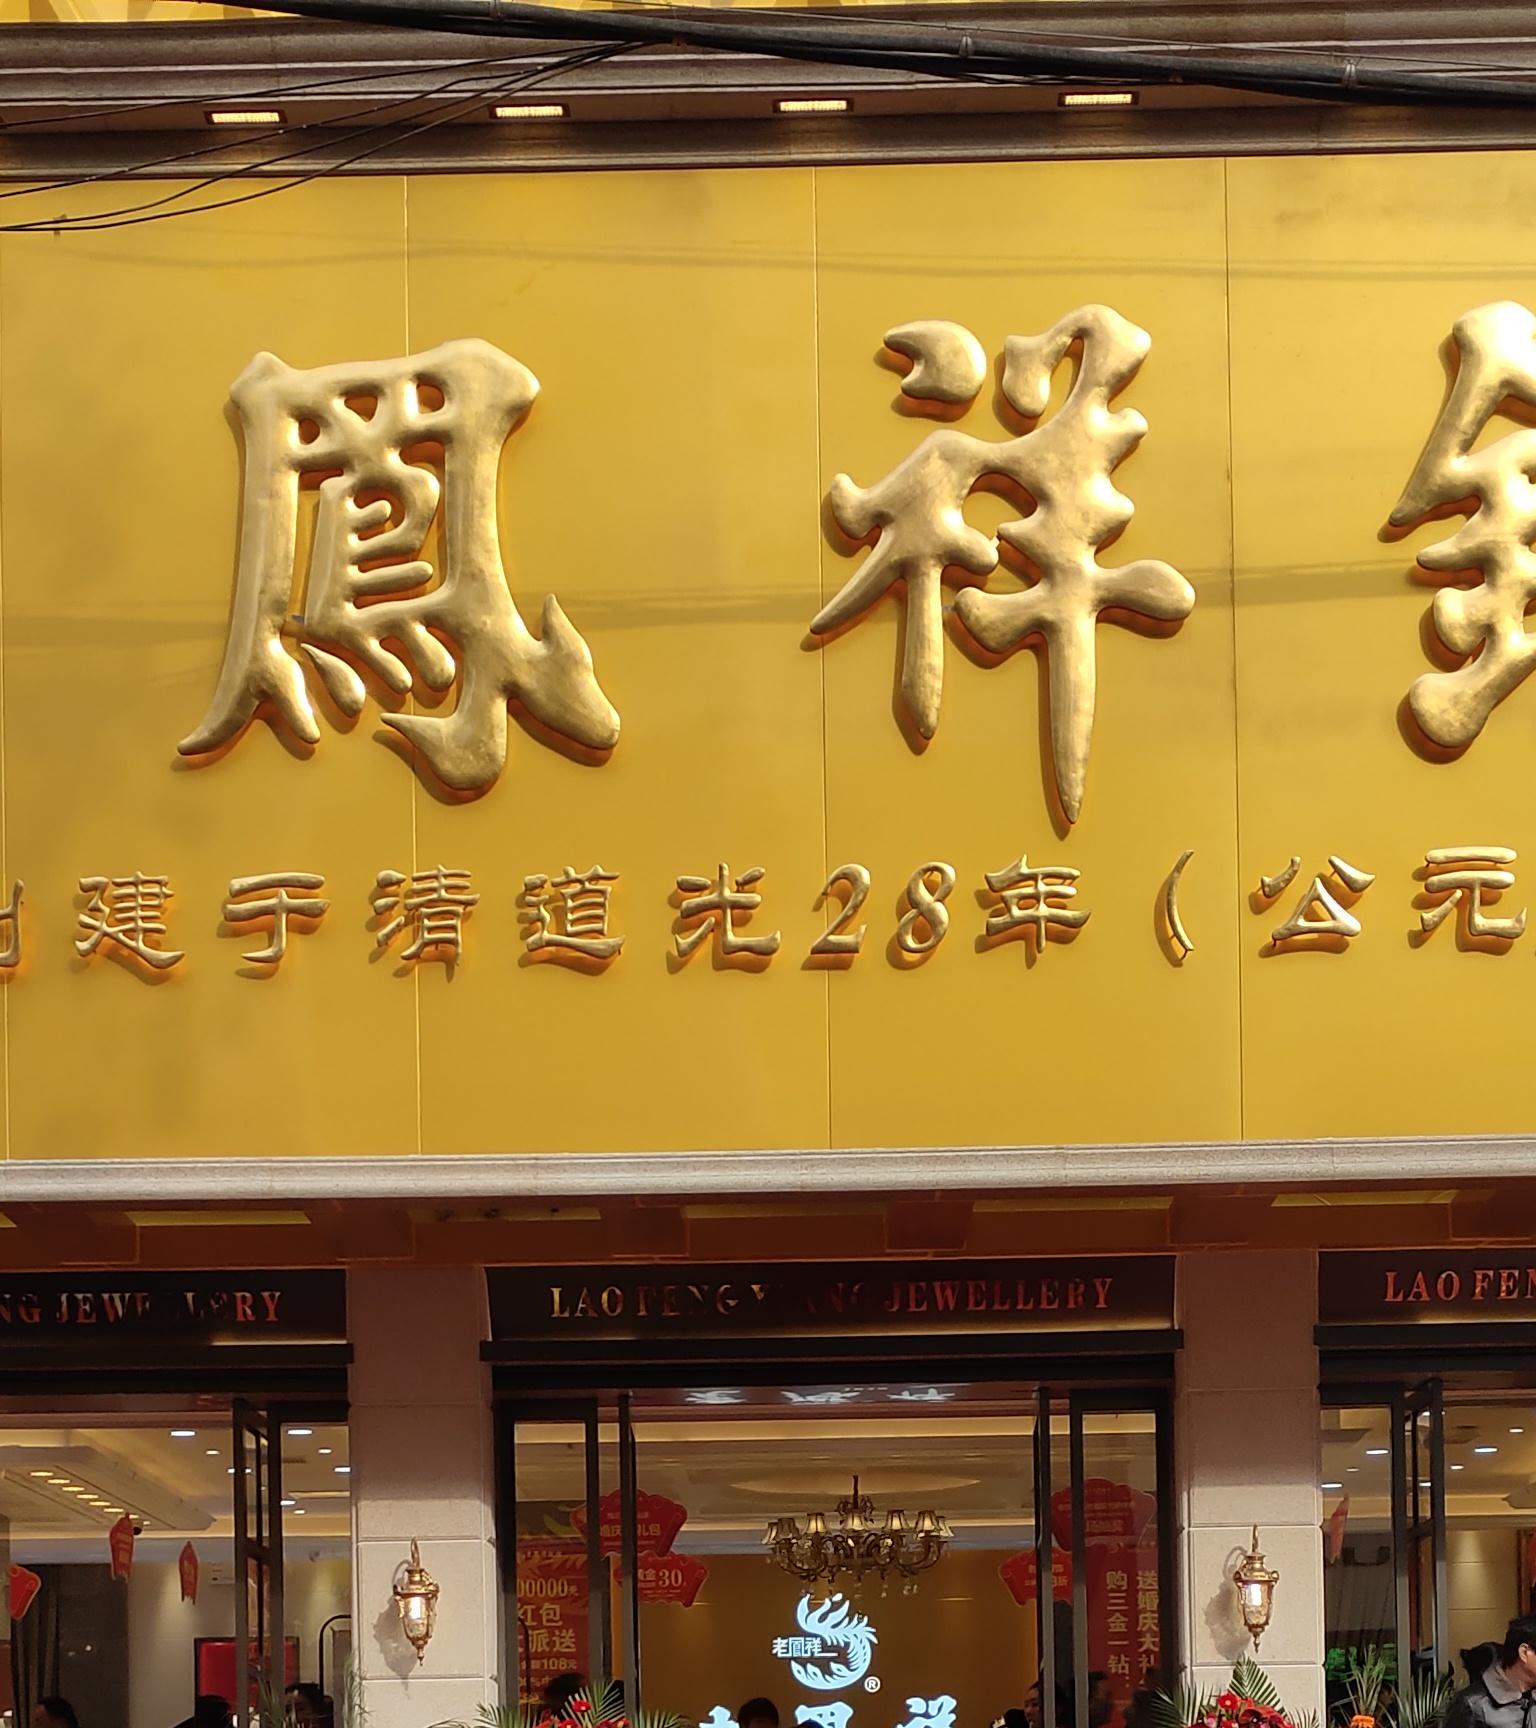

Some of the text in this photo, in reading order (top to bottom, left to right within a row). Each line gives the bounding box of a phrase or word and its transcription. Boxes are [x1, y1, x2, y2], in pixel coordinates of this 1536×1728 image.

[550, 1286, 625, 1318] LAO
[885, 1278, 1113, 1312] JEWELLERY
[1384, 1270, 1462, 1301] LAO
[518, 1628, 577, 1652] 派送
